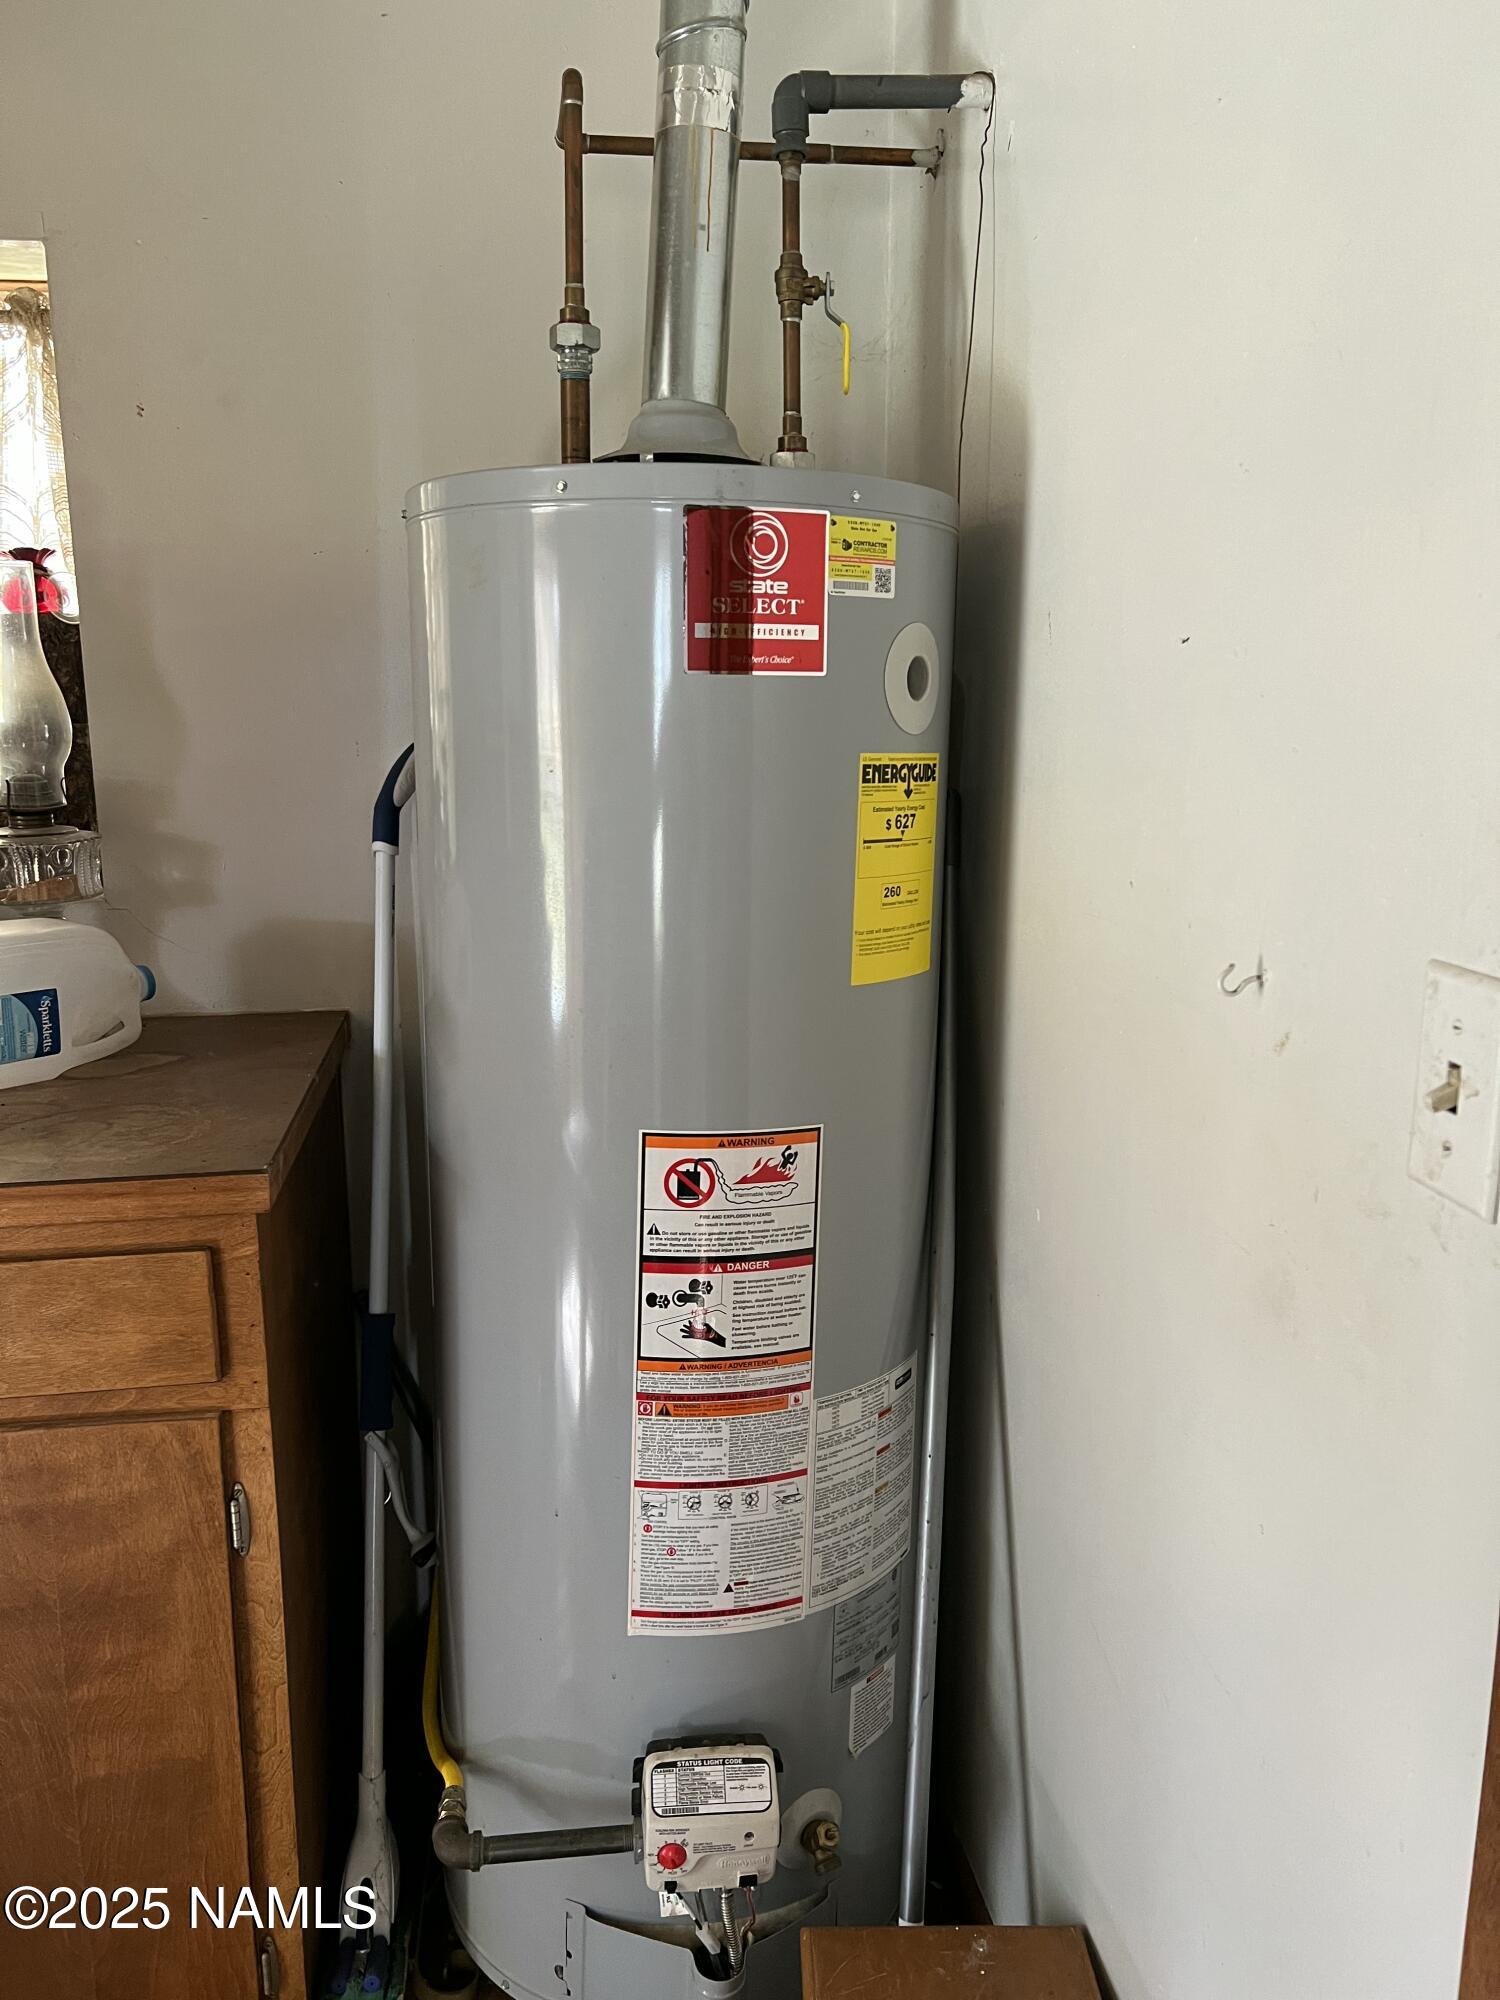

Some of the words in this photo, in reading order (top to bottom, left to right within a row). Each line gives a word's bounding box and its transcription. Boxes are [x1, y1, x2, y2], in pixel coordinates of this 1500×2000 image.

[730, 579, 788, 594] state
[713, 597, 800, 614] SELECT
[862, 763, 936, 784] ENERGYGUIDE
[886, 819, 892, 831] $
[895, 814, 916, 829] 627
[884, 886, 901, 898] 260
[38, 1000, 53, 1053] Sparkletts
[727, 1137, 775, 1147] WARNING
[727, 1260, 770, 1271] DANGER
[728, 1358, 778, 1368] ADVERTENCIA
[720, 1855, 770, 1869] Honeywell
